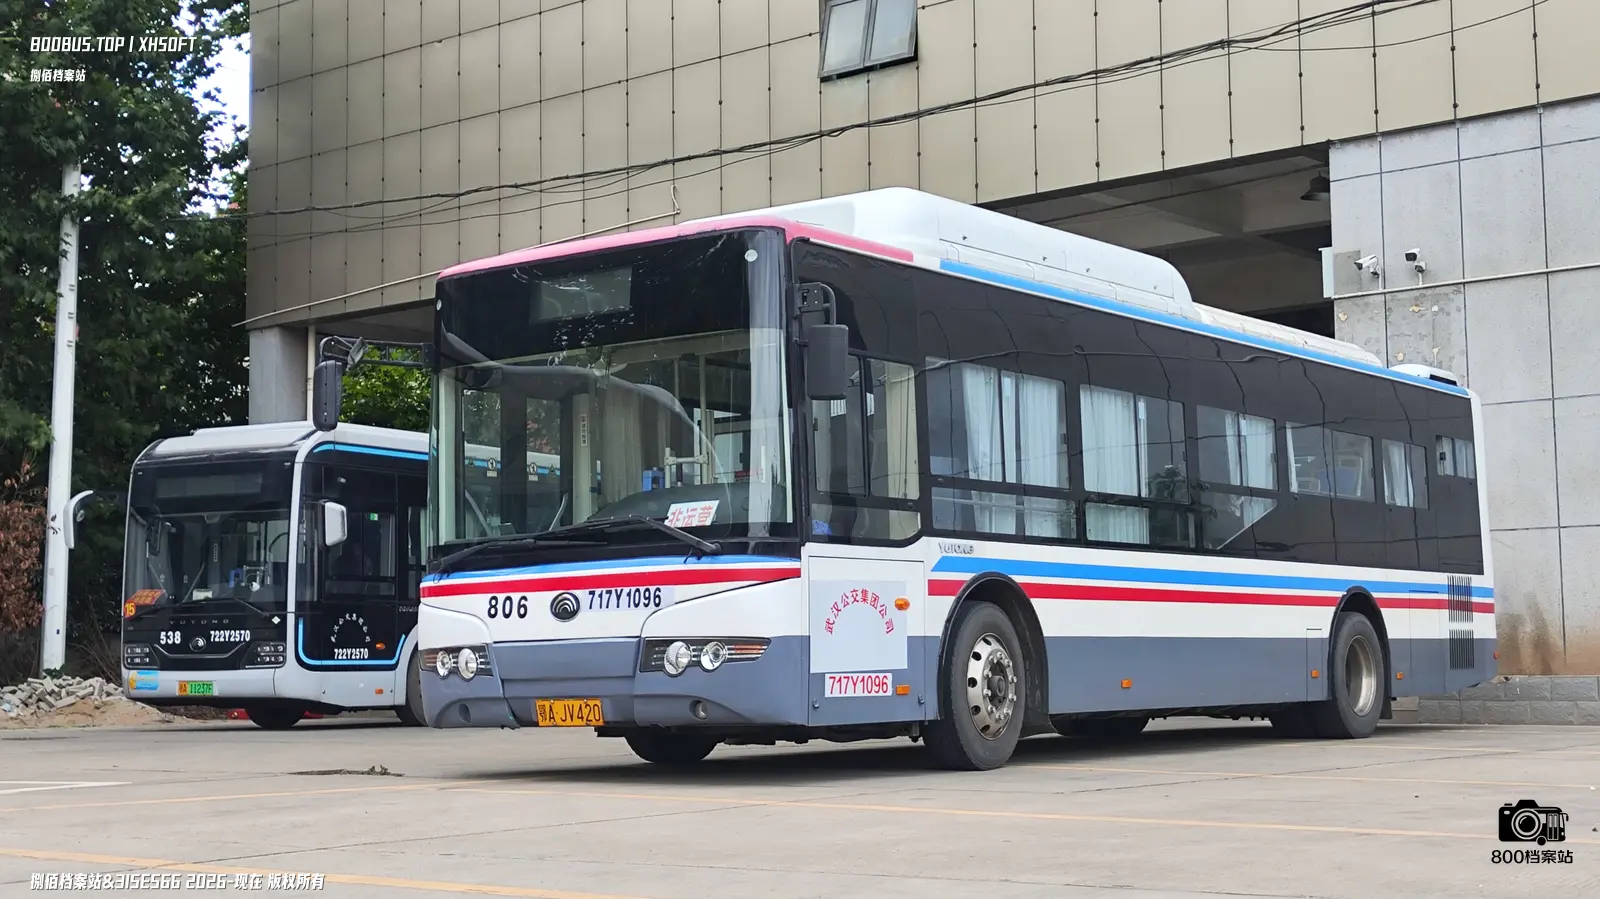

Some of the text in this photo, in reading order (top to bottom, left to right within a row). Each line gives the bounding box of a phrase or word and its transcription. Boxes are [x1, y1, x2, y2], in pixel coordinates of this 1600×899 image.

[668, 504, 713, 527] 非运营
[487, 595, 528, 619] 806
[588, 587, 662, 609] 717Y1096
[124, 602, 136, 617] 15
[824, 588, 895, 635] 武汉公交集团公司
[160, 631, 181, 644] 538
[210, 630, 251, 642] 722Y2570
[333, 648, 369, 660] 722Y2570
[828, 674, 889, 695] 717Y1096
